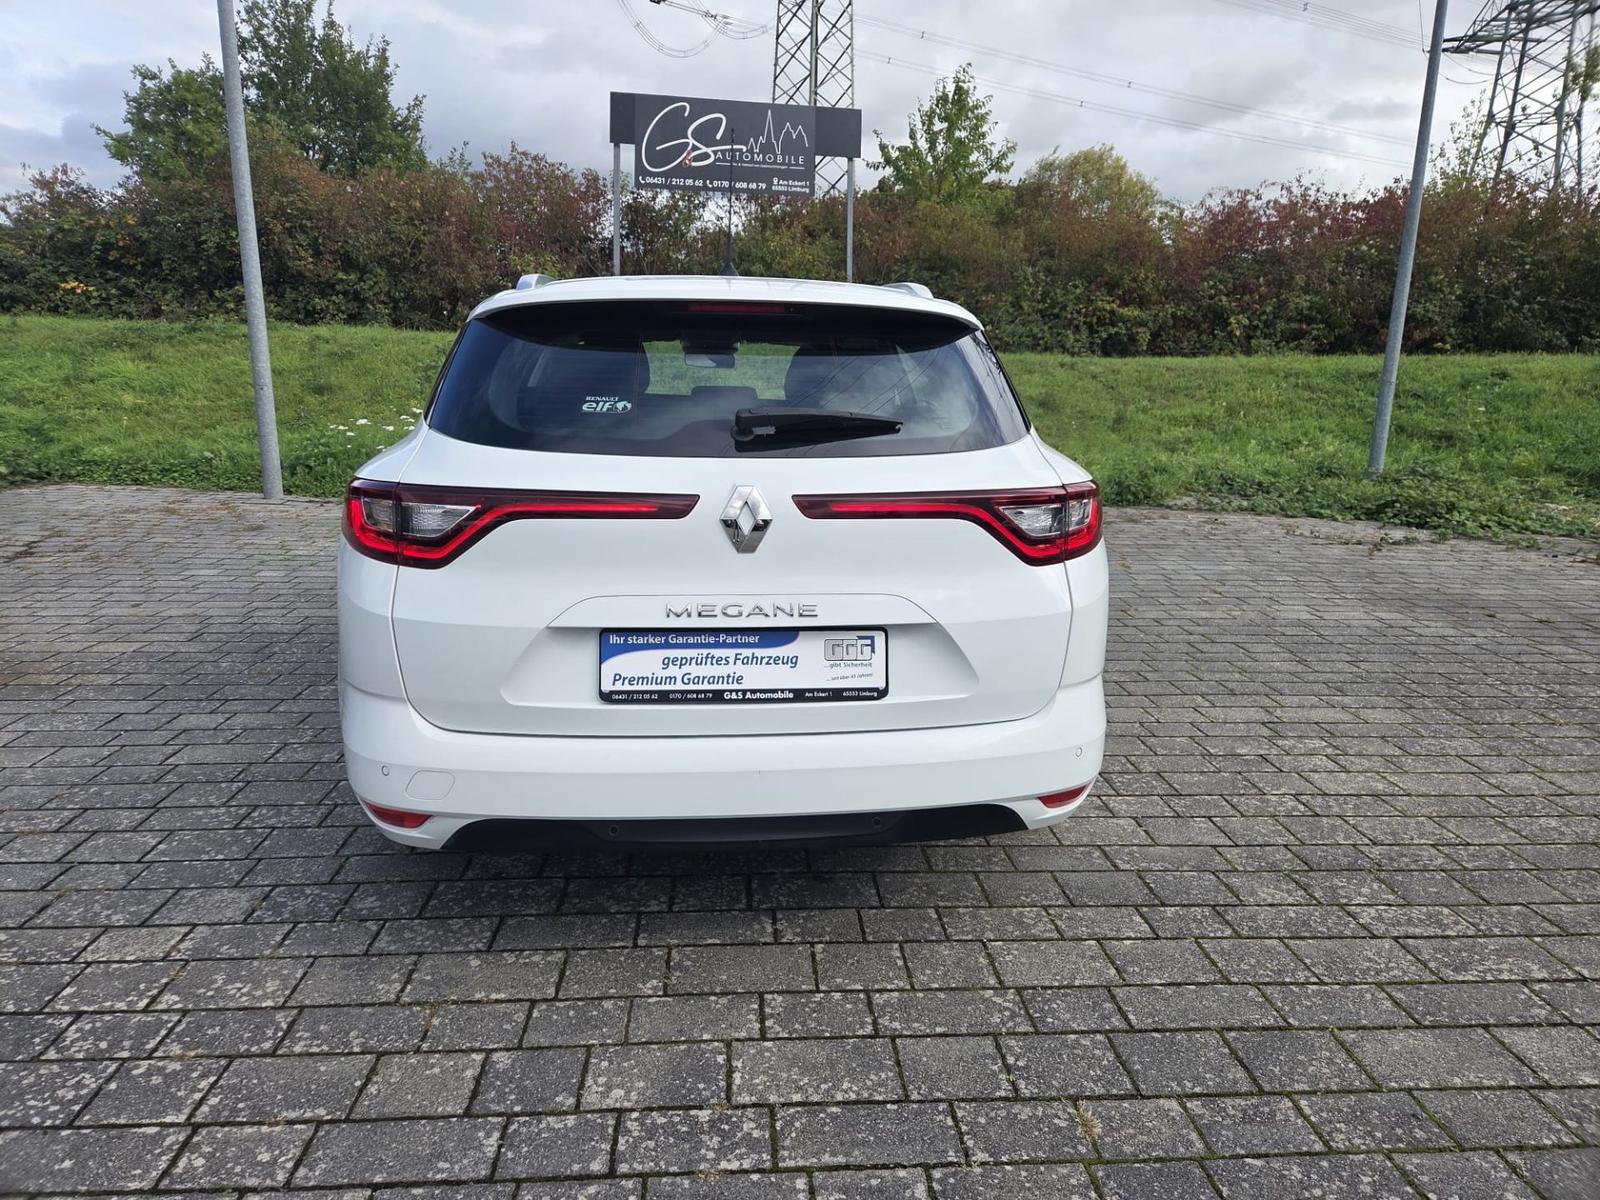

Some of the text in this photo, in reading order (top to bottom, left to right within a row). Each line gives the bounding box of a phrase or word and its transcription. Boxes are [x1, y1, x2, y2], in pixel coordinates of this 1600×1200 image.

[715, 151, 805, 165] AUTOMOBILE
[645, 176, 665, 184] 06431
[672, 178, 684, 186] 212
[695, 179, 704, 187] 62
[713, 180, 729, 188] 0170
[735, 181, 748, 189] 608
[748, 182, 757, 190] 68
[758, 182, 767, 190] 79
[788, 186, 810, 194] Limburg
[582, 401, 615, 411] elf
[665, 602, 819, 618] MEGANE
[609, 633, 760, 644] Ihr starker Garantie-Partner
[661, 652, 799, 670] geprüftes Fahrzeug
[612, 672, 744, 686] Premium Garantie
[723, 690, 794, 699] G&S Automobile
